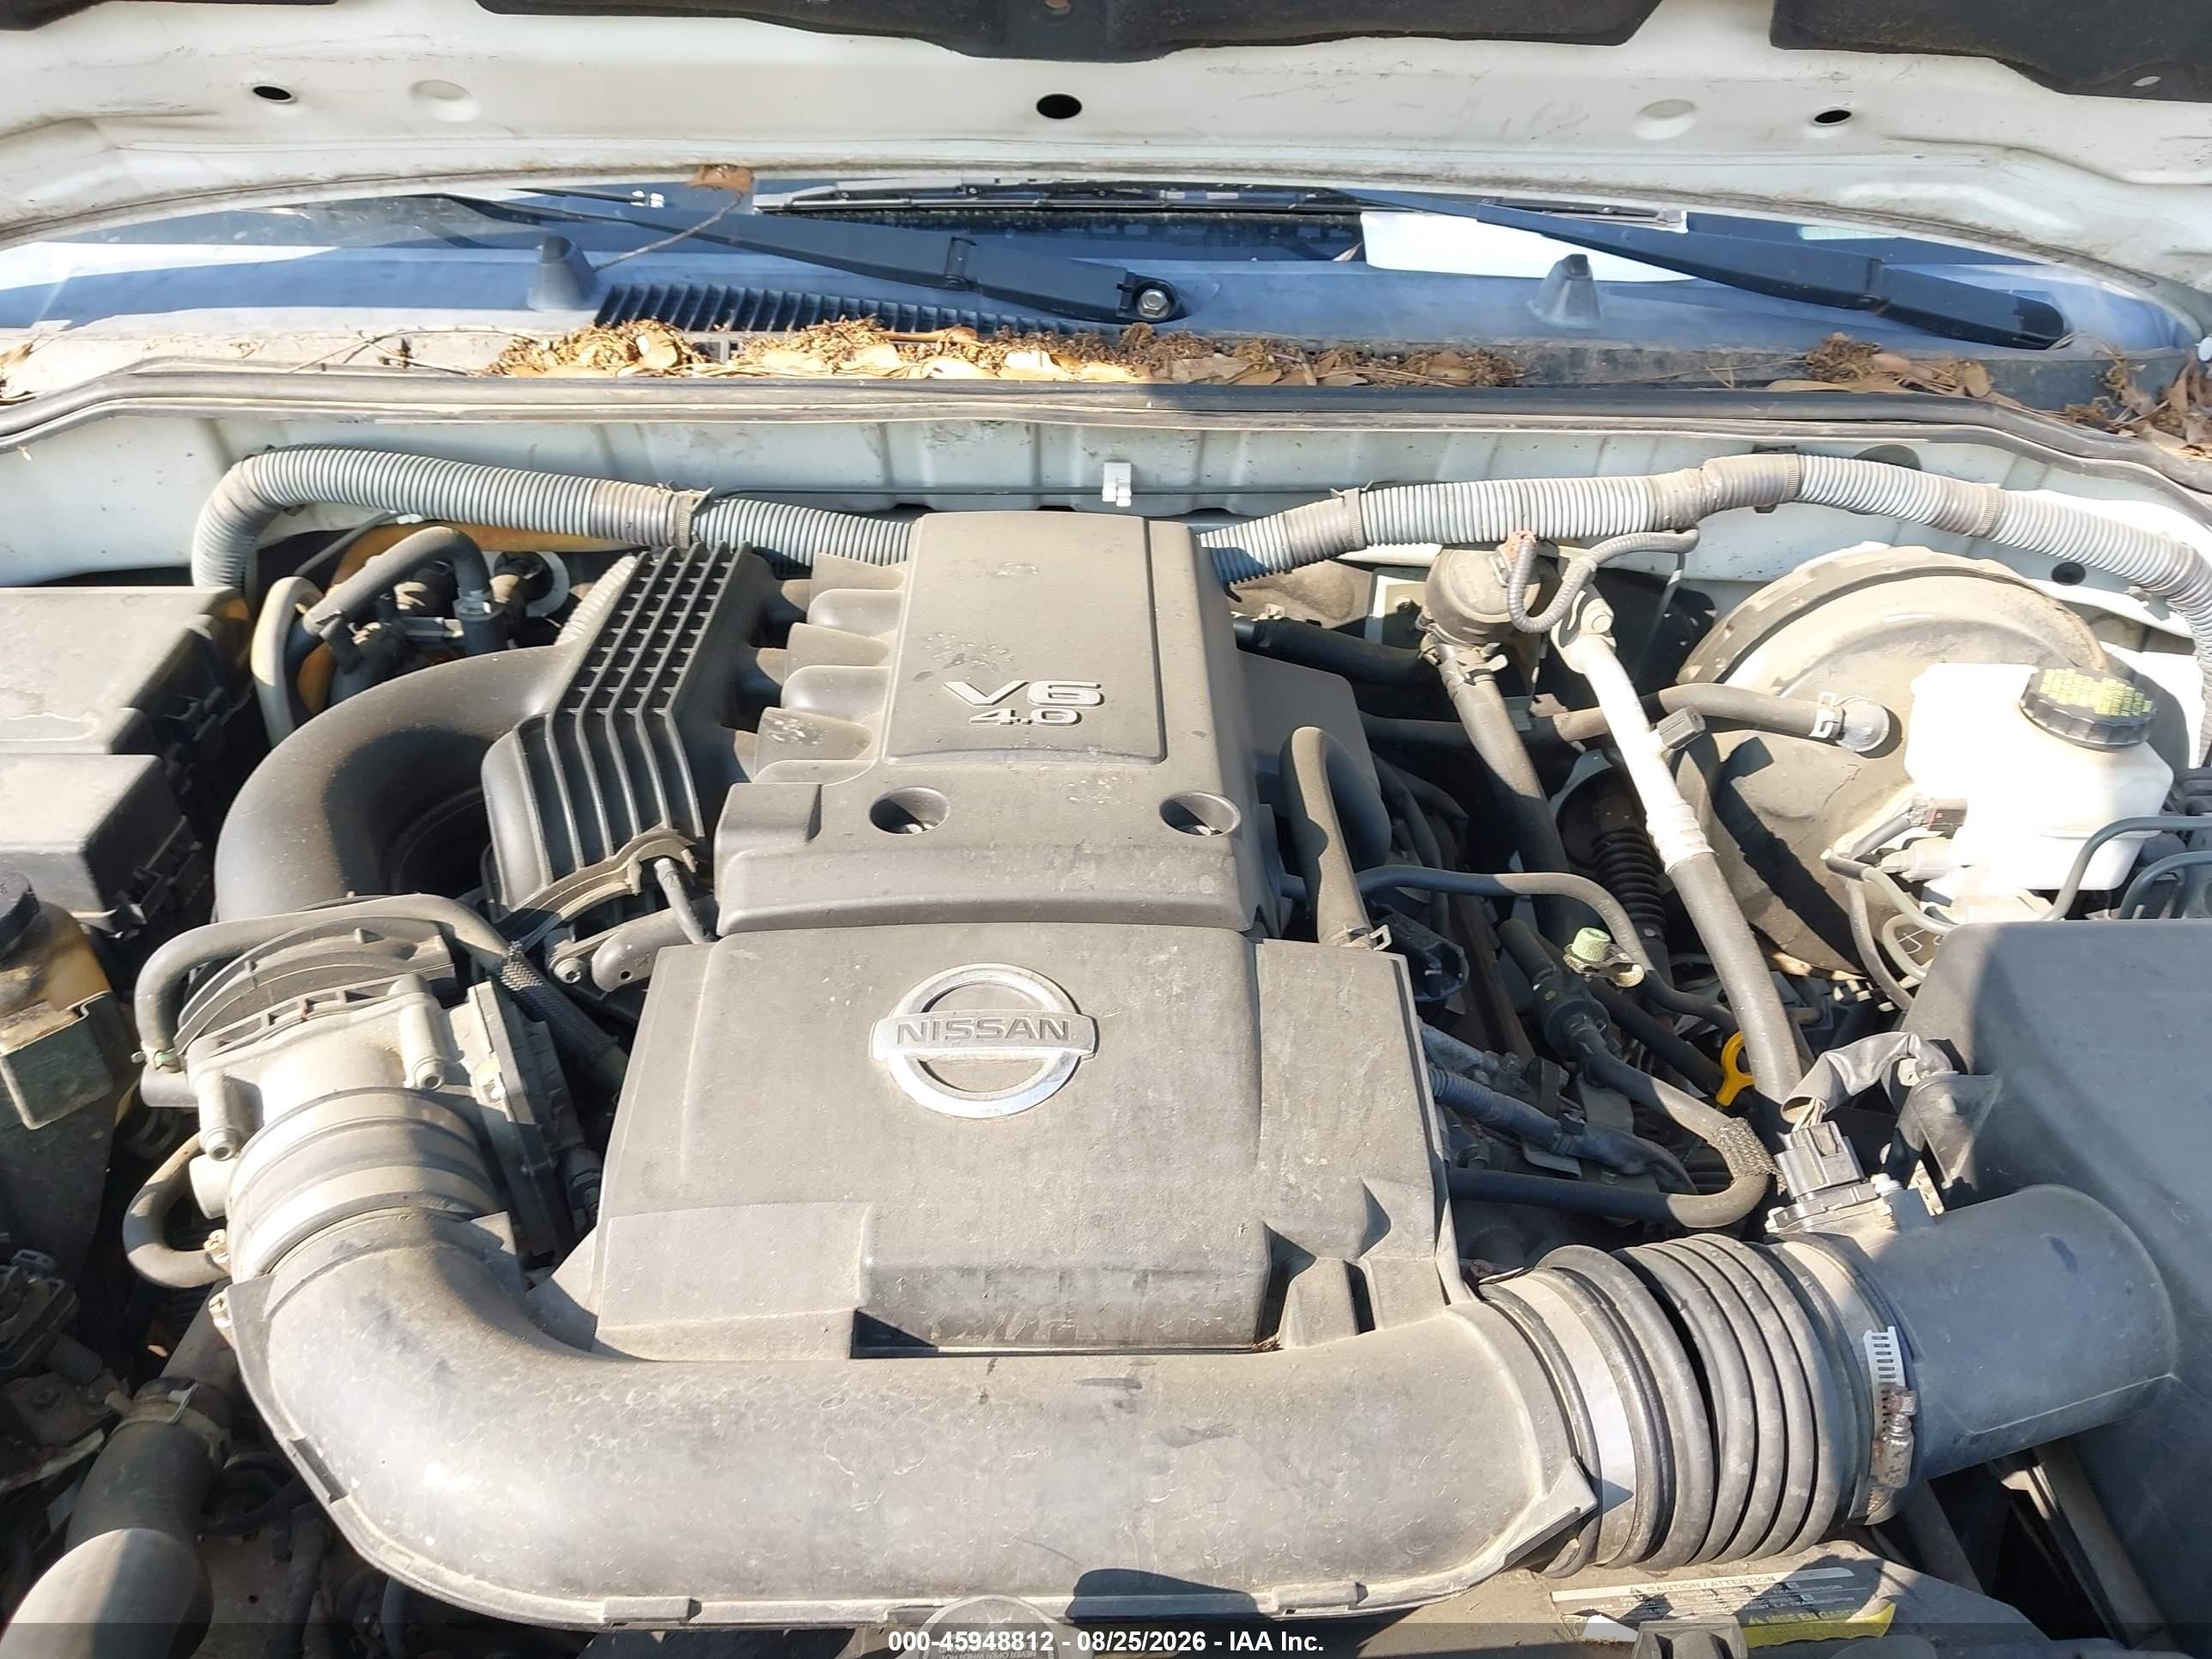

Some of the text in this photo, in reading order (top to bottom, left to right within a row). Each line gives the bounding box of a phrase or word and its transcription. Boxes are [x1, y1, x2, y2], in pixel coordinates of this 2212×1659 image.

[944, 680, 1105, 707] V6
[969, 708, 1082, 726] 4.0
[896, 1017, 1071, 1044] NISSAN
[1647, 1581, 1701, 1592] CAUTION
[1710, 1575, 1777, 1587] ATTENTION
